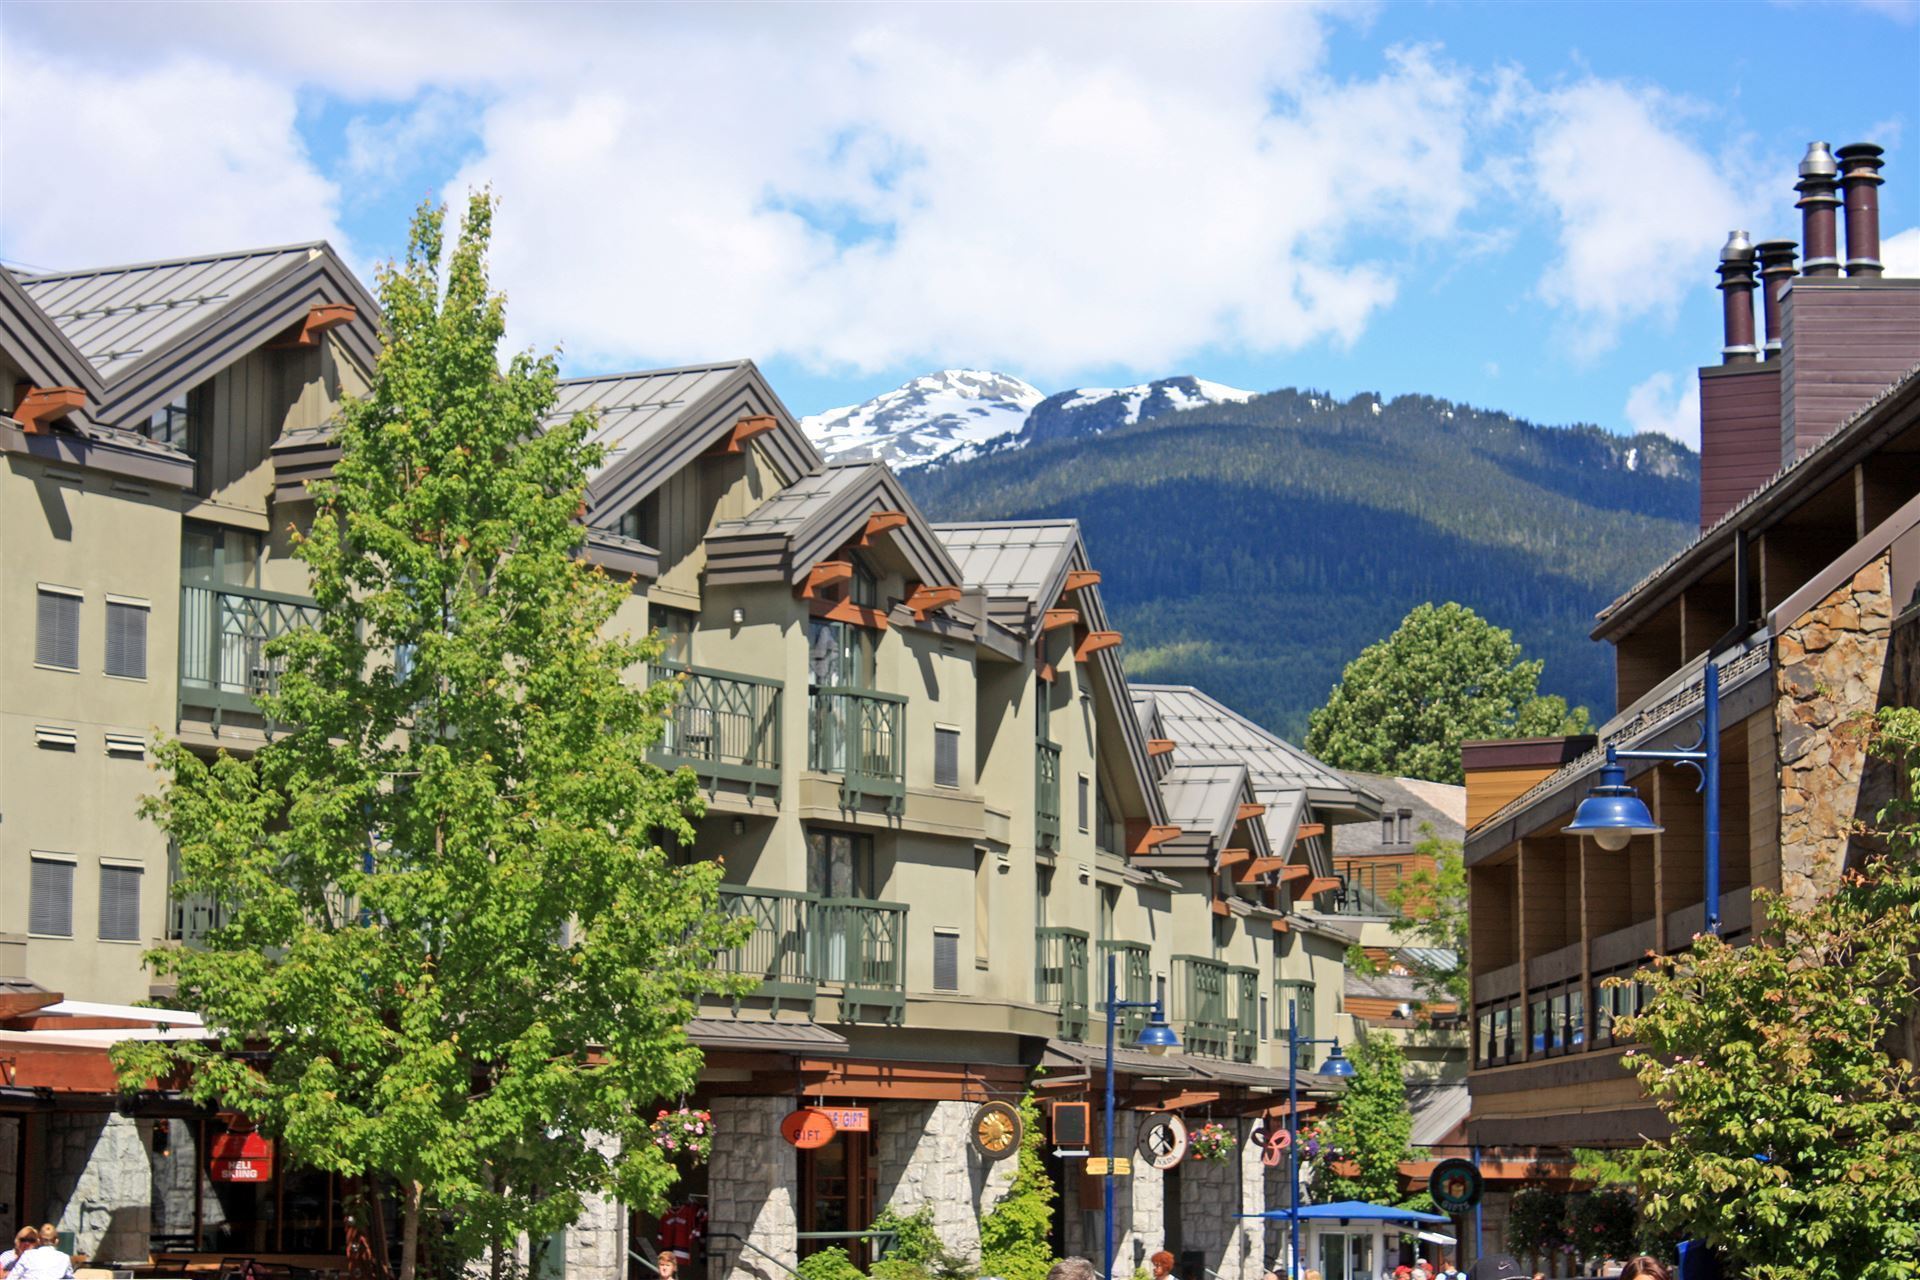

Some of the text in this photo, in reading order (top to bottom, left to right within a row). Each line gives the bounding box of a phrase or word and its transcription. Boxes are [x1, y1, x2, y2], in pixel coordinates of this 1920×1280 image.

[843, 1111, 864, 1127] GIFT
[793, 1129, 820, 1141] GIFT
[228, 1160, 251, 1169] HELI
[221, 1169, 258, 1179] SKIING
[1441, 1200, 1470, 1211] GIFTS
